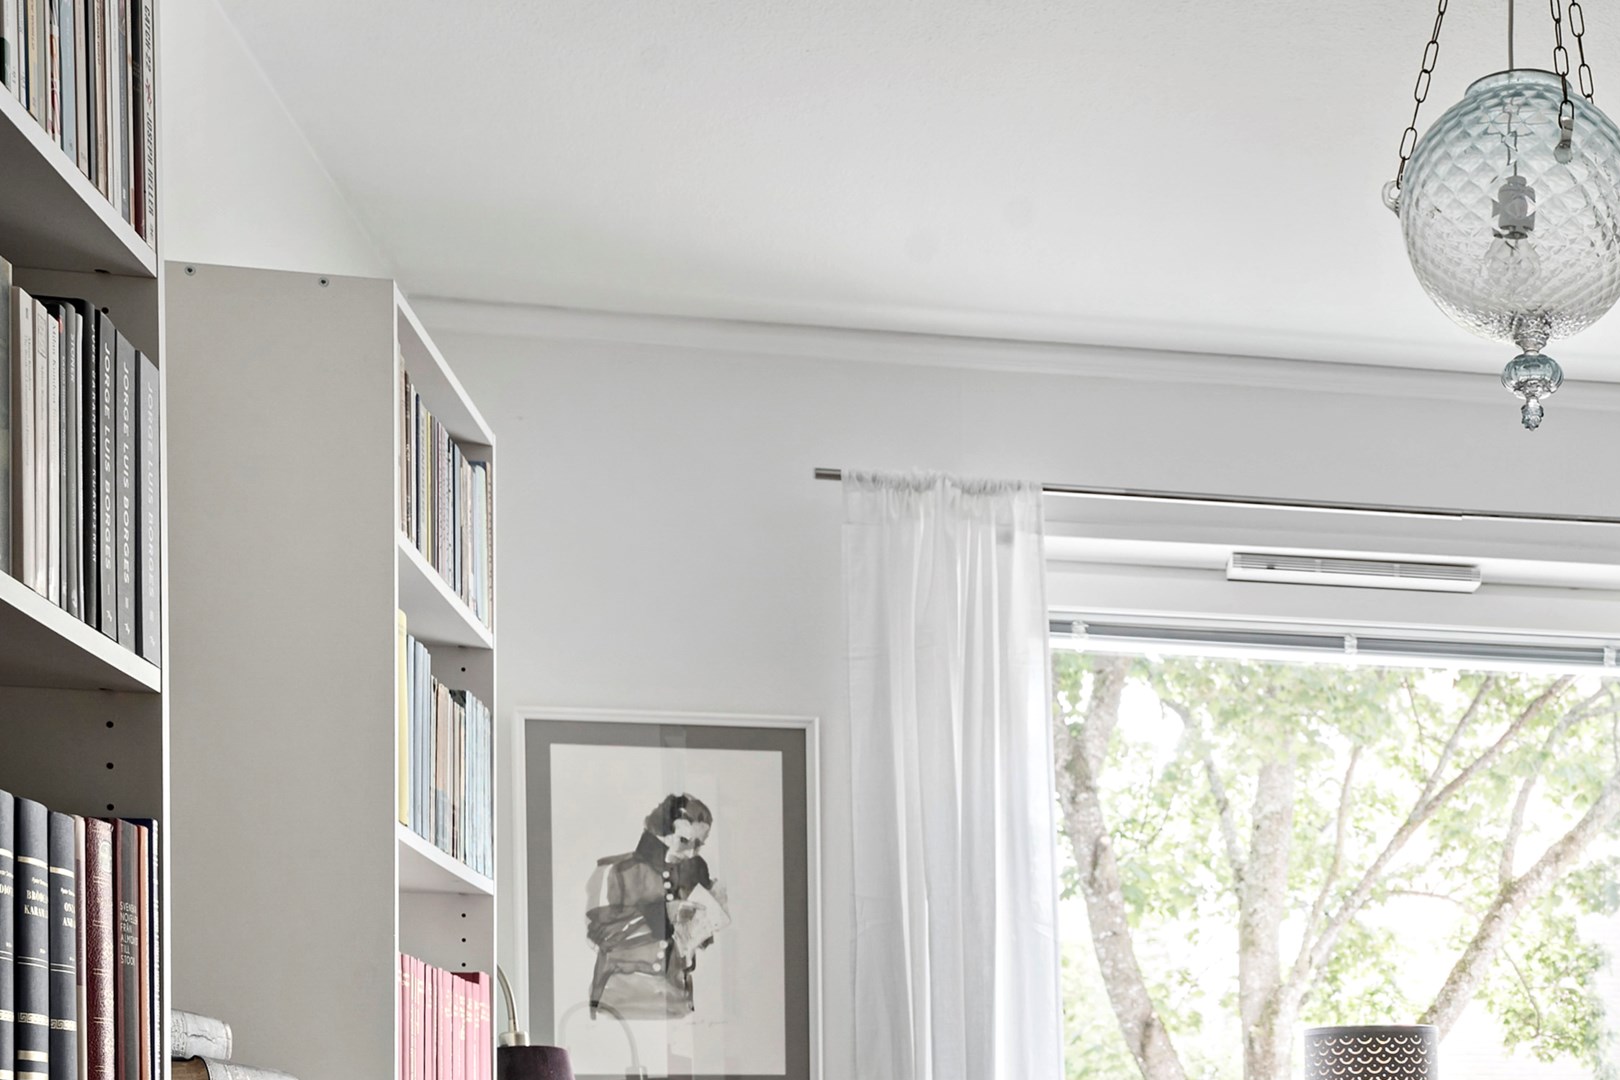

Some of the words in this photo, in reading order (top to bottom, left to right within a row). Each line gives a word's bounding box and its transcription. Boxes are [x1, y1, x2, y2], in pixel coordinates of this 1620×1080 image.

[144, 5, 152, 72] CATCH-22
[146, 112, 154, 164] JOSEPH
[103, 343, 111, 419] JORGE
[122, 362, 130, 437] JORGE
[122, 442, 130, 489] LUIS
[104, 480, 112, 570] BORGES
[122, 496, 130, 584] BORGES
